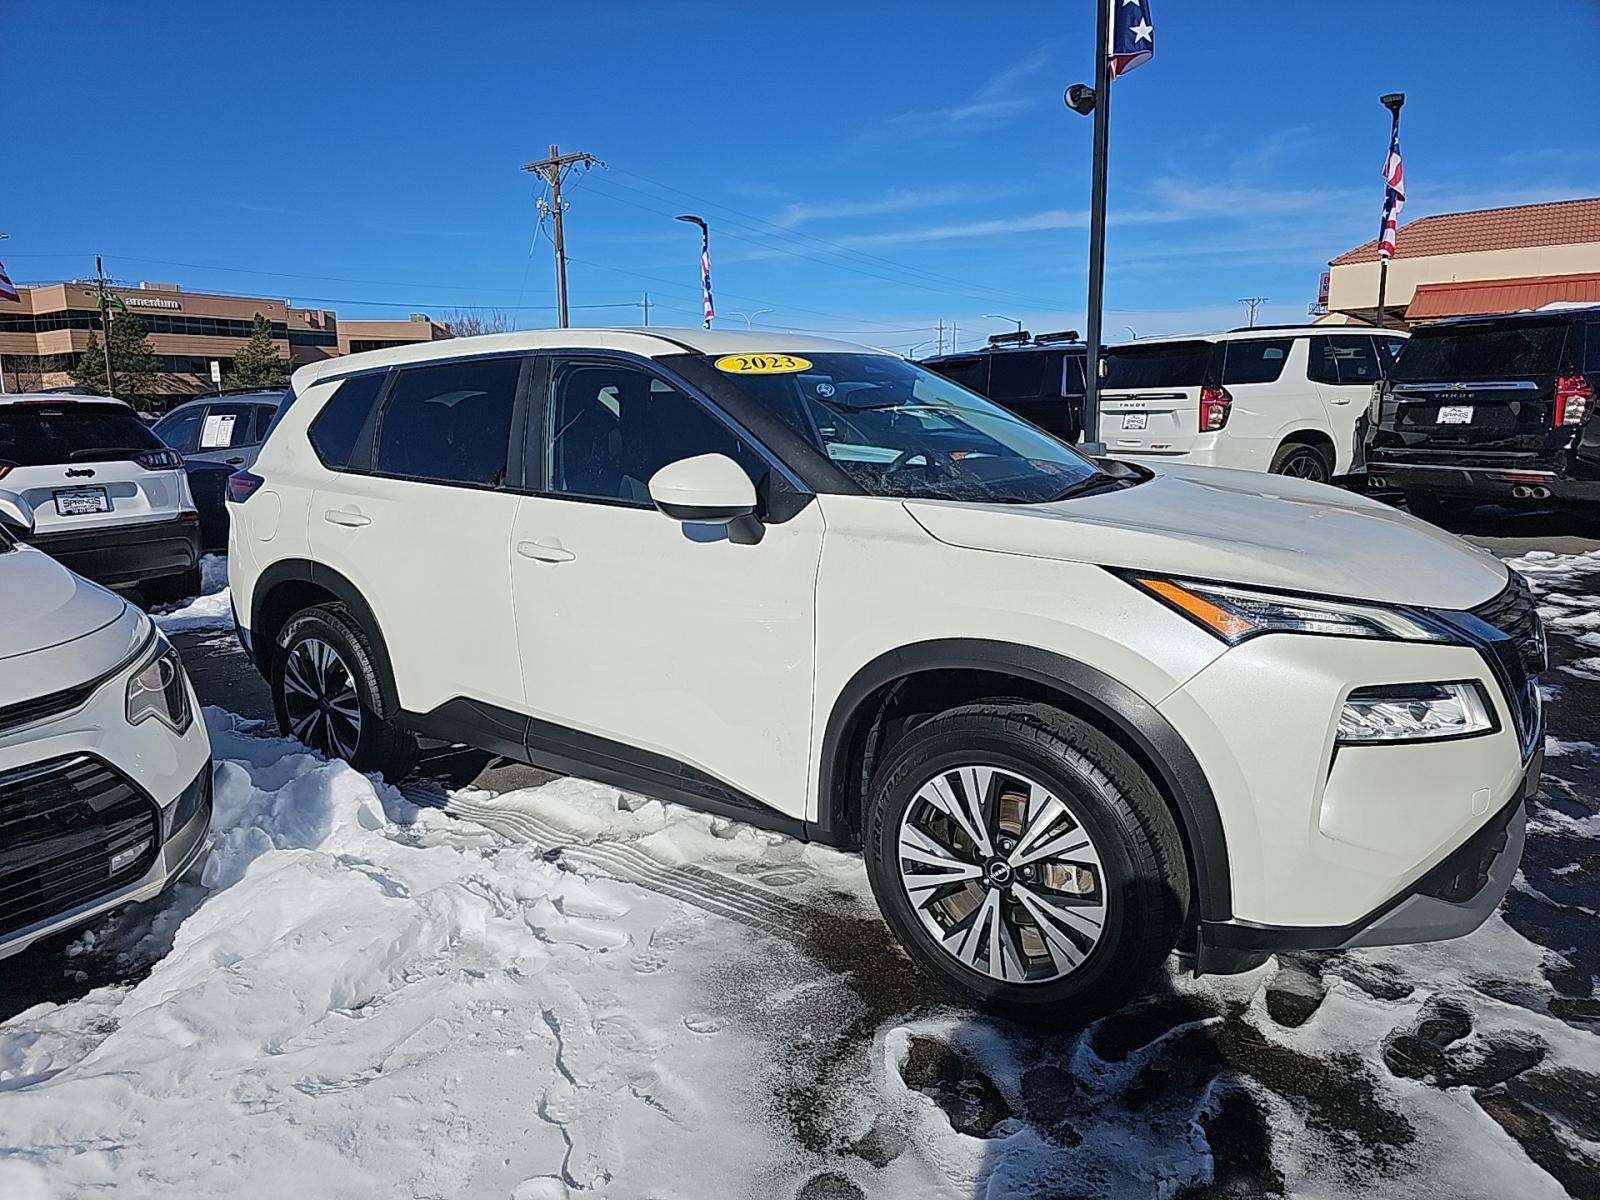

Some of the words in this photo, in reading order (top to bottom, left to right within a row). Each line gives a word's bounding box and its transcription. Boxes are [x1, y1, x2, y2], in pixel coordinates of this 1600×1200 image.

[125, 297, 178, 309] amentum
[735, 357, 796, 371] 2023
[65, 468, 95, 478] Jeep
[63, 497, 101, 508] SPRINGS
